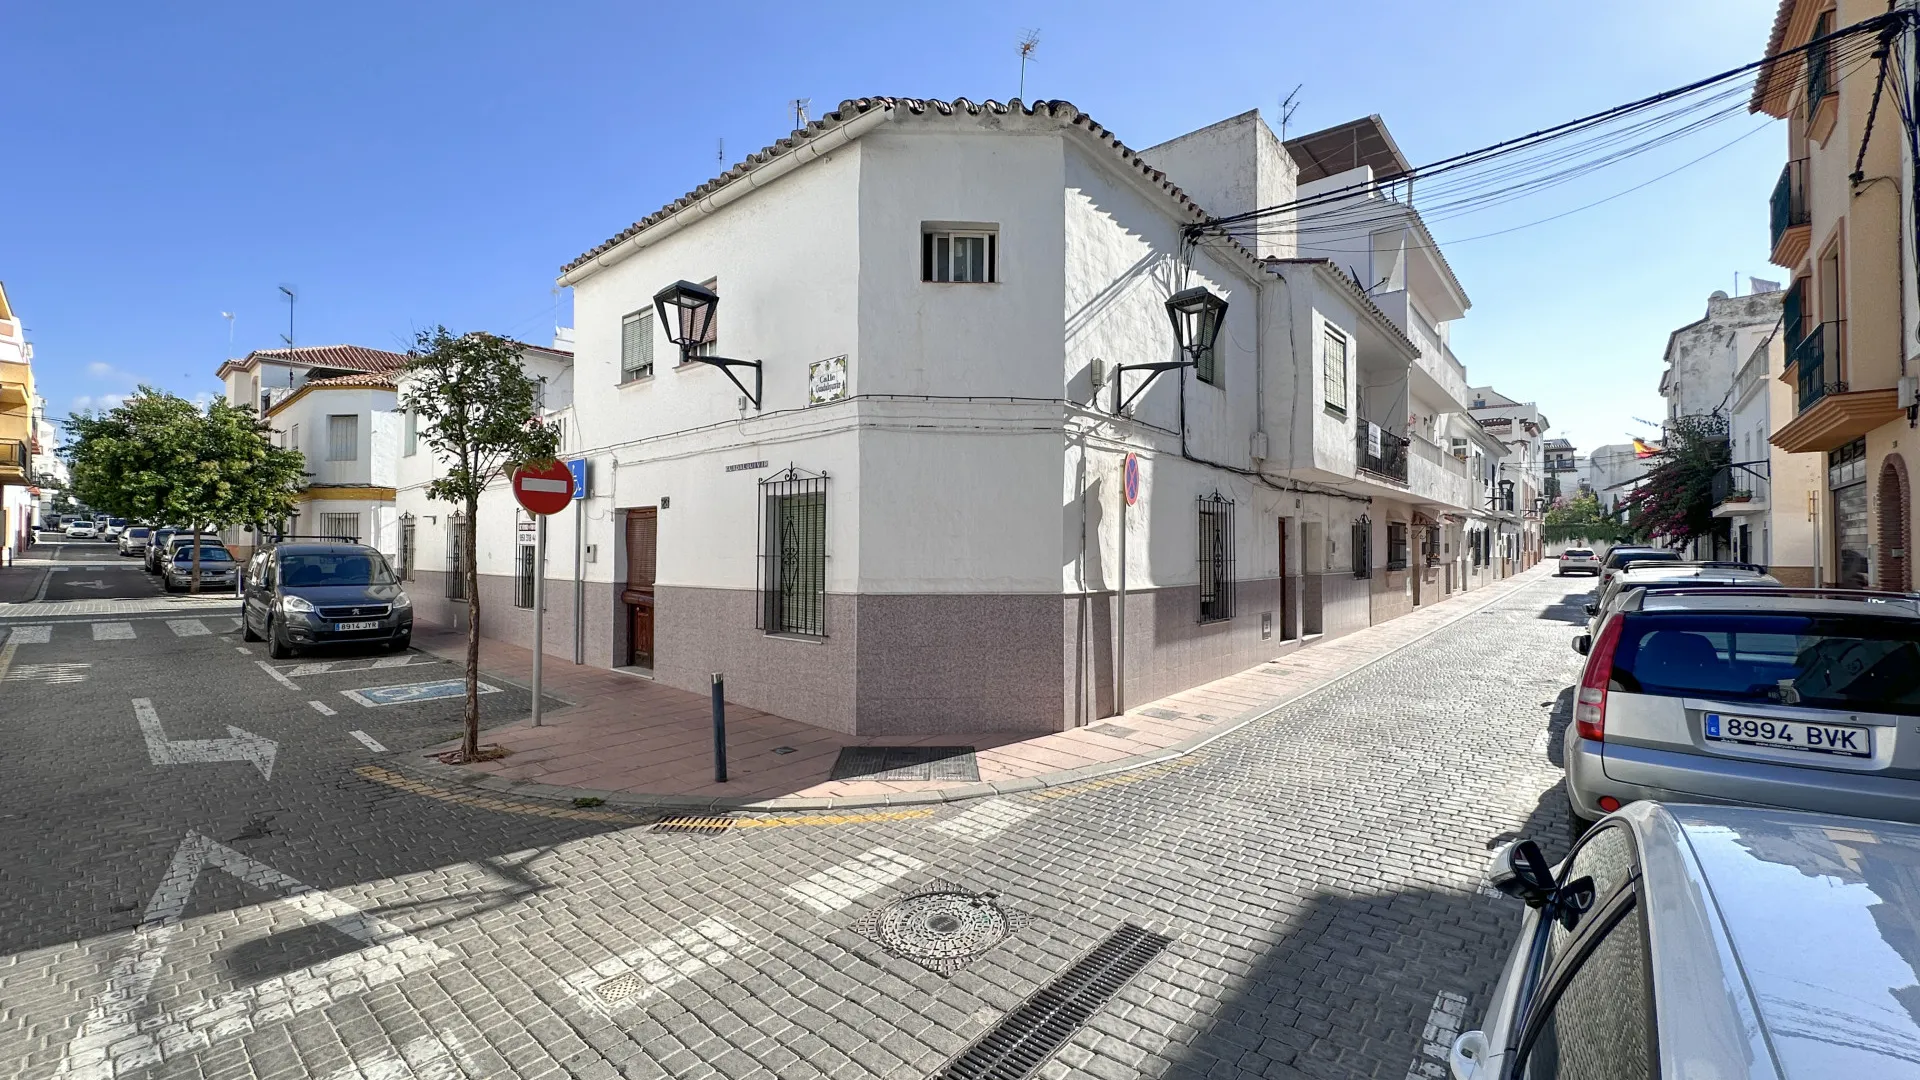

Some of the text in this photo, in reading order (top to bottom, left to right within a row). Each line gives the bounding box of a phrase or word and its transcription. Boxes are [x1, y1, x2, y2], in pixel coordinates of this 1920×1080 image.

[820, 373, 836, 384] Calle
[362, 621, 377, 629] JYR
[1727, 718, 1858, 750] 8994 BVK
